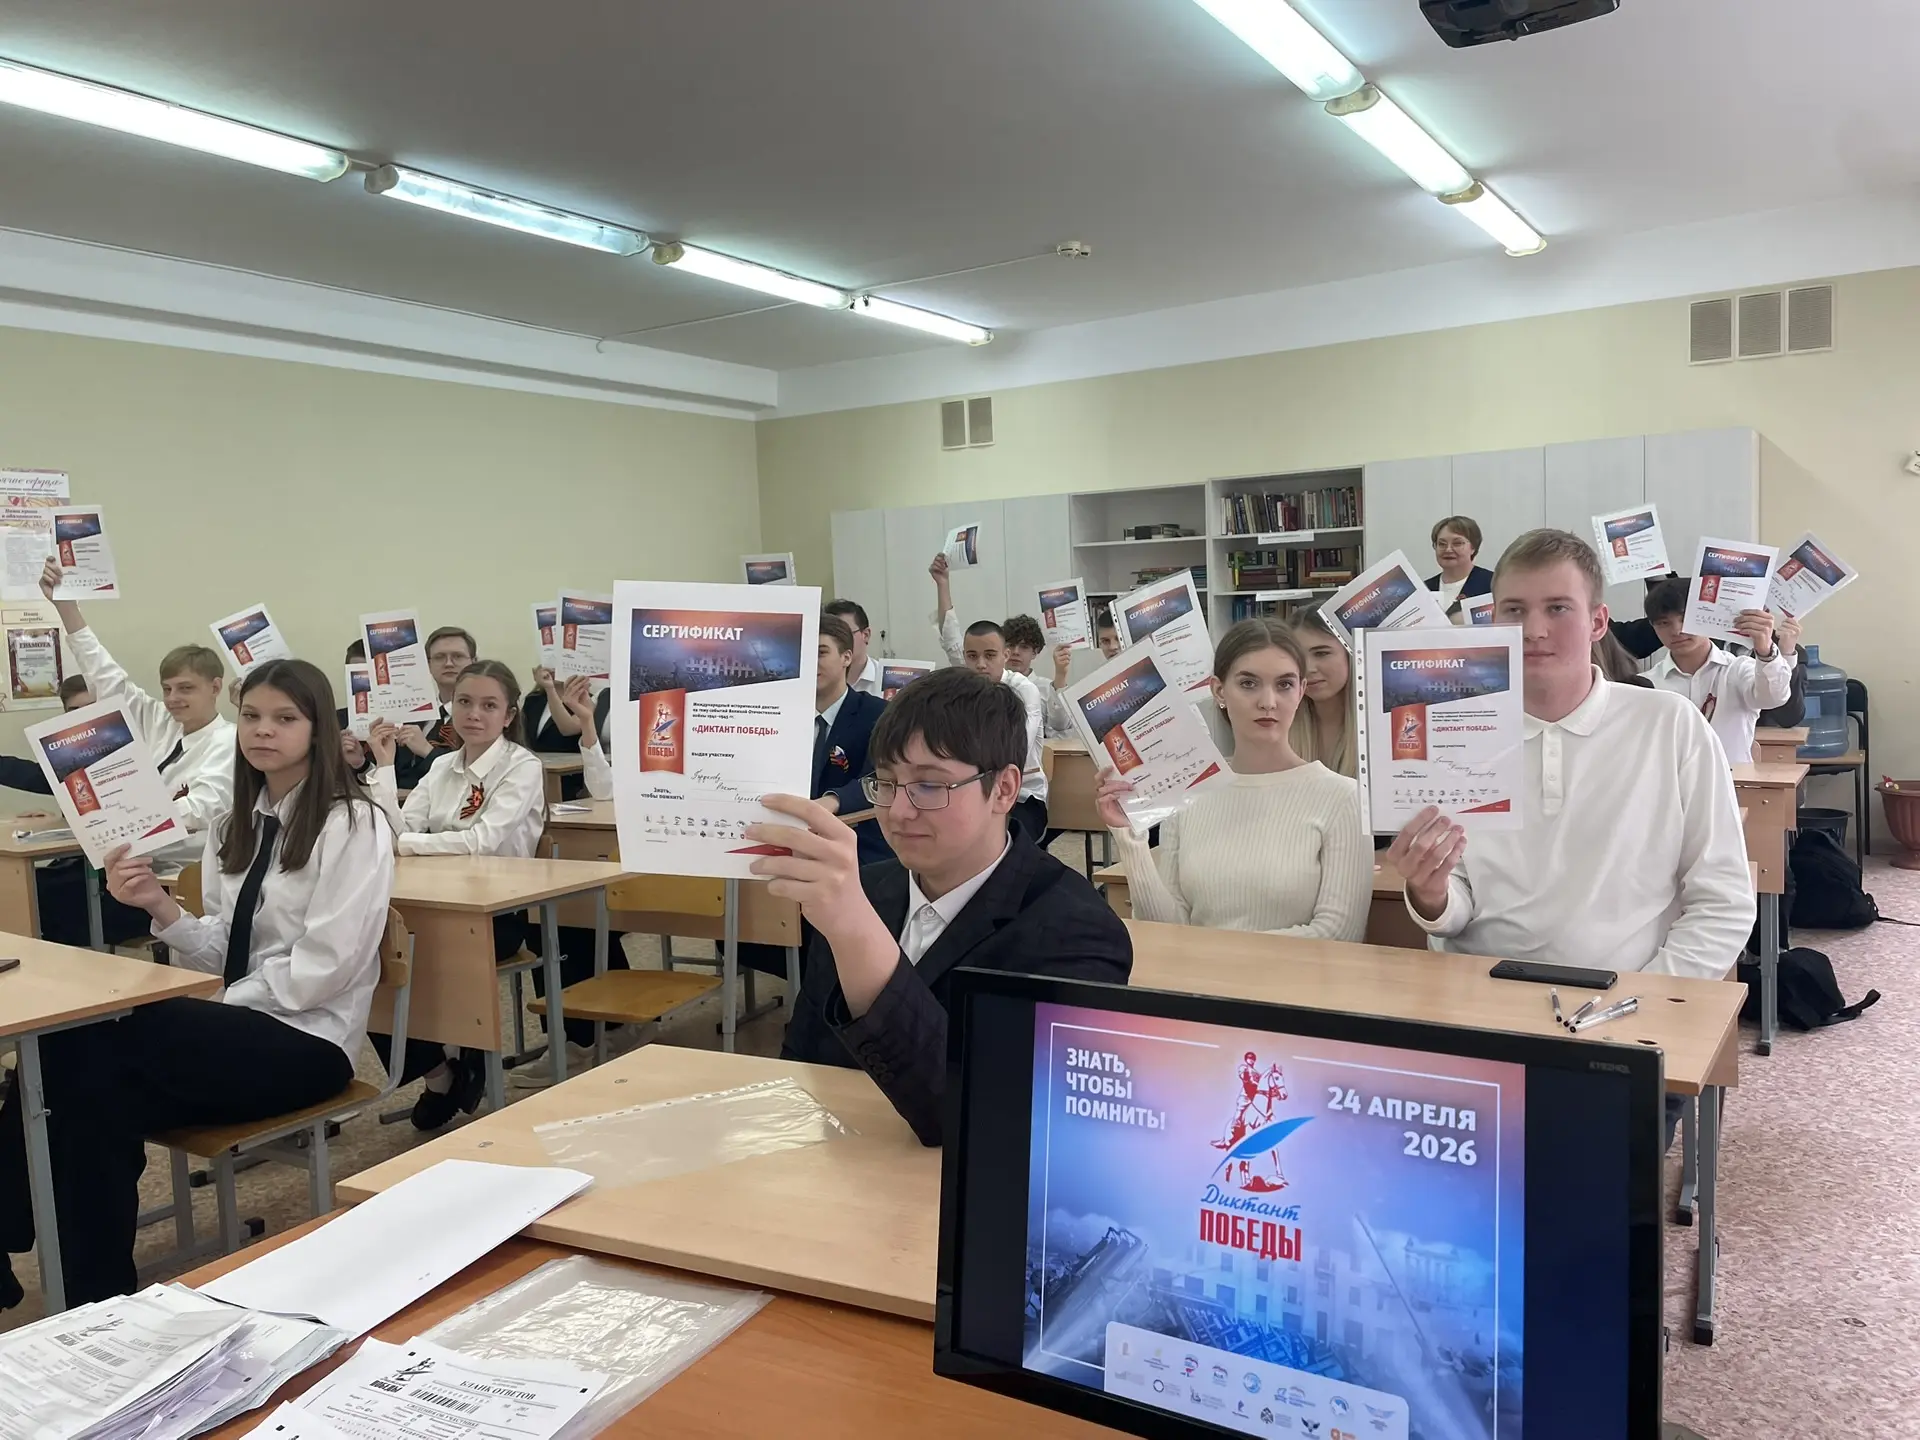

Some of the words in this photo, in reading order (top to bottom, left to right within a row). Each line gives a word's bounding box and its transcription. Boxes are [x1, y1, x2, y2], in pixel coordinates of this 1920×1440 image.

[1342, 587, 1381, 620] СЕРТИФИКАТ
[642, 624, 744, 641] СЕРТИФИКАТ
[1390, 658, 1465, 670] СЕРТИФИКАТ
[1085, 679, 1130, 711] СЕРТИФИКАТ
[48, 727, 97, 751] СЕРТИФИКАТ
[692, 724, 735, 734] «ДИКТАНТ
[736, 726, 779, 736] ПОБЕДЫ»
[647, 747, 675, 757] ПОБЕДЫ
[1066, 1047, 1131, 1078] ЗНАТЬ,
[1066, 1071, 1132, 1100] ЧТОБЫ
[1065, 1095, 1166, 1130] ПОМНИТЬ!
[1327, 1086, 1361, 1114] 24
[1367, 1096, 1476, 1131] АПРЕЛЯ
[1403, 1131, 1477, 1166] 2026
[1201, 1184, 1301, 1221] Диктант
[1200, 1208, 1302, 1262] ПОБЕДЫ
[460, 1380, 491, 1393] БЛАНК
[491, 1388, 536, 1400] ОТВЕТОВ
